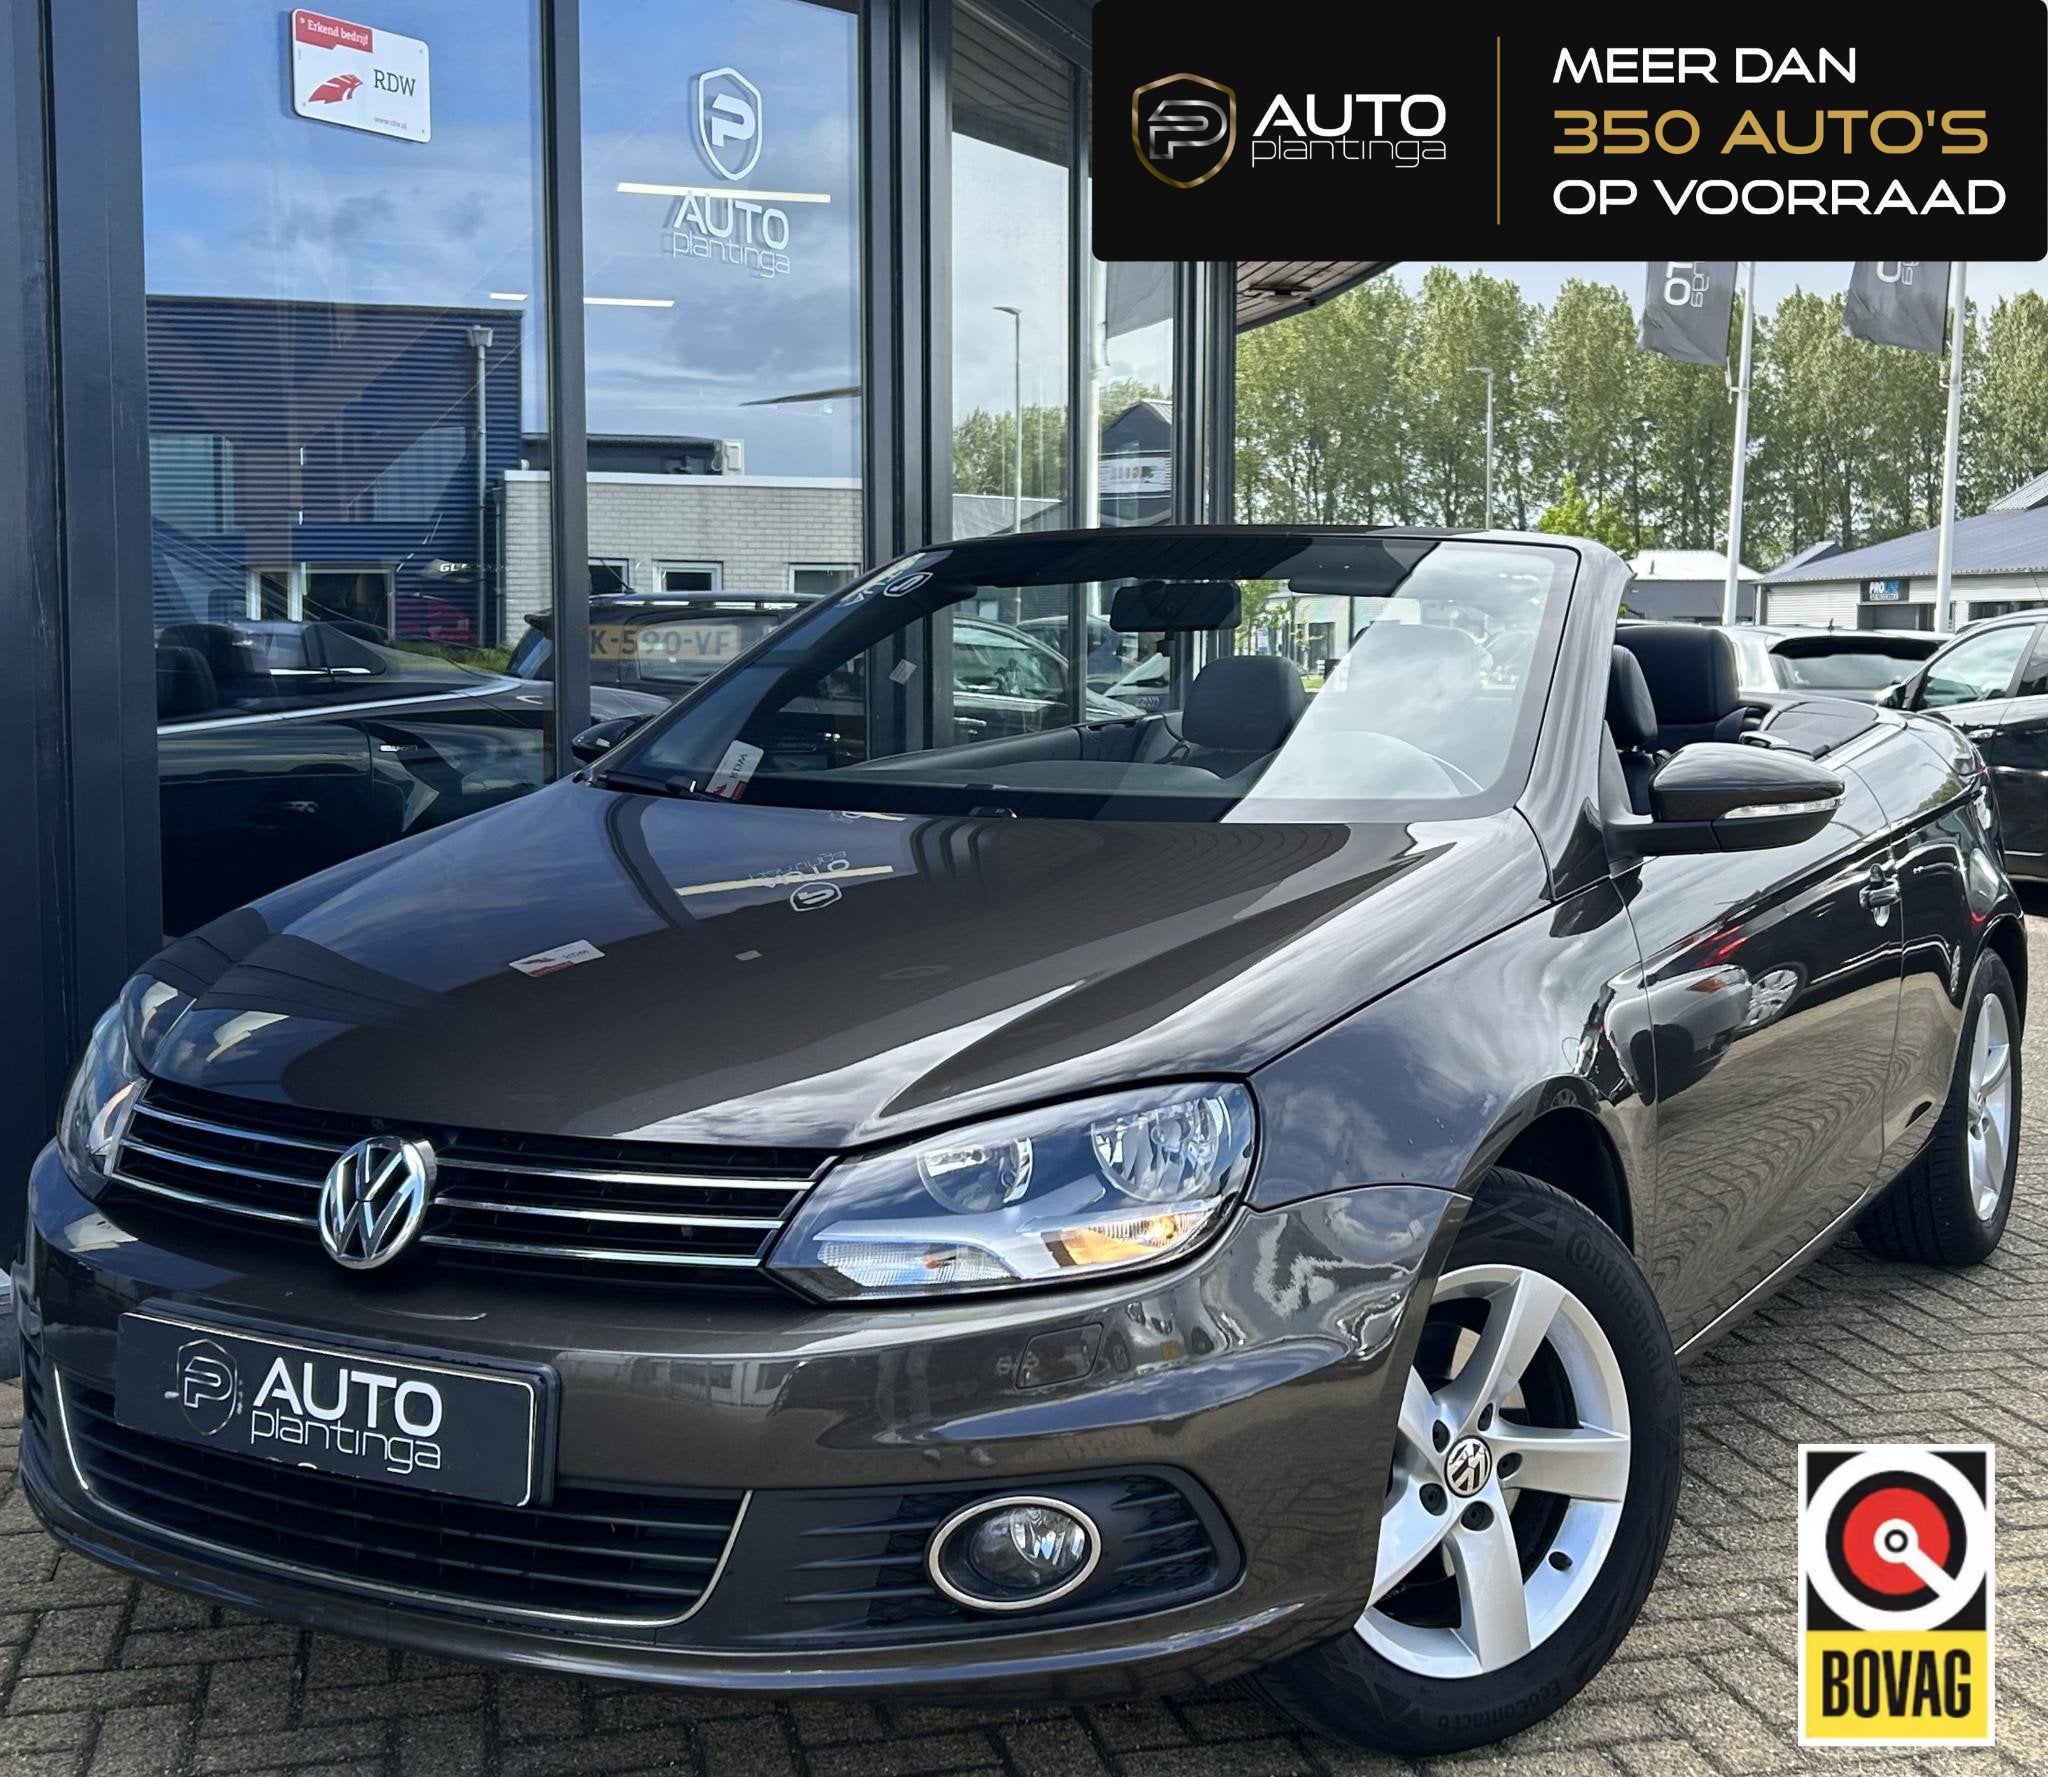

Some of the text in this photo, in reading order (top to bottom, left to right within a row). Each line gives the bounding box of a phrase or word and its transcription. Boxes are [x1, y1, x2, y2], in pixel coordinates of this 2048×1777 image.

[308, 19, 368, 46] Erkend bedrijf
[373, 69, 416, 97] RDW
[673, 189, 790, 250] AUTO
[672, 231, 791, 278] plantinga
[253, 1357, 443, 1438] AUTO
[250, 1408, 442, 1475] plantinga
